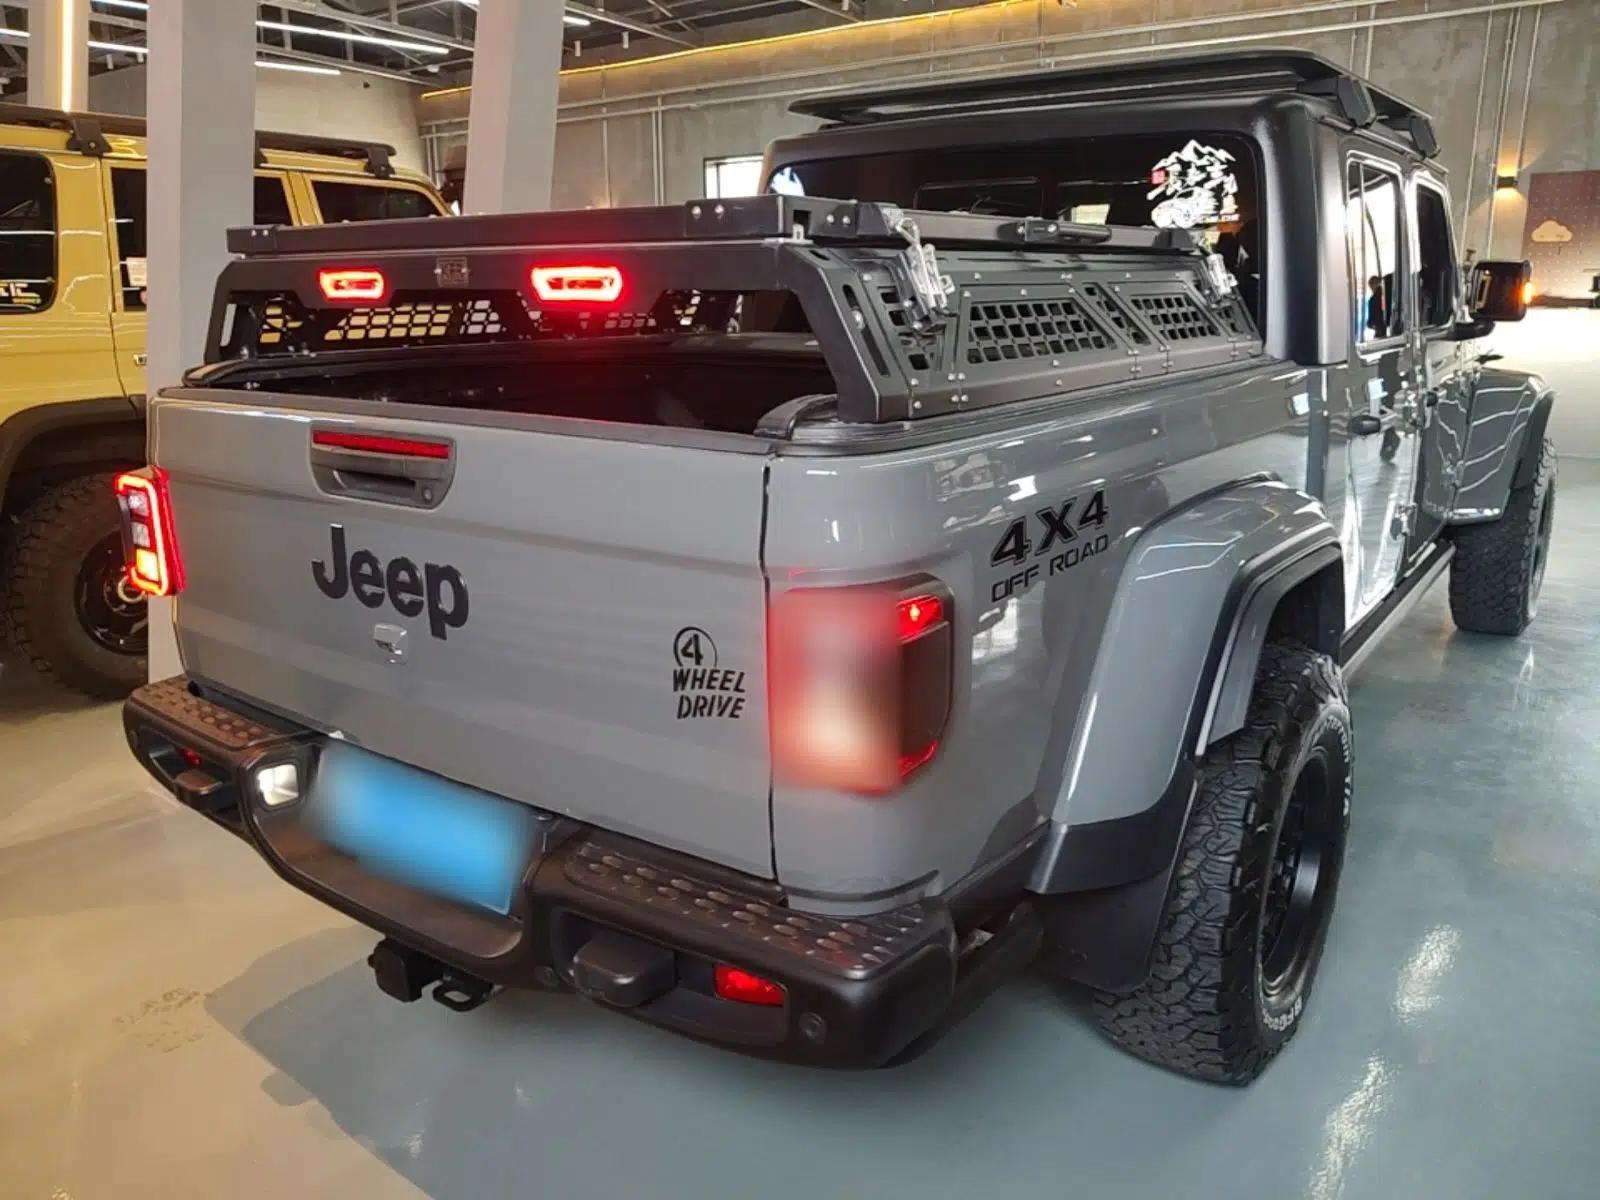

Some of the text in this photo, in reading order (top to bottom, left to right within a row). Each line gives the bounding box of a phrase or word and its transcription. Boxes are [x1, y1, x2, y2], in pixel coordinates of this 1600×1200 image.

[989, 486, 1110, 568] 4X4
[311, 523, 470, 641] Jeep
[991, 533, 1109, 603] OFF ROAD
[680, 633, 704, 666] 4
[672, 667, 746, 693] WHEEL
[676, 694, 746, 719] DRIVE
